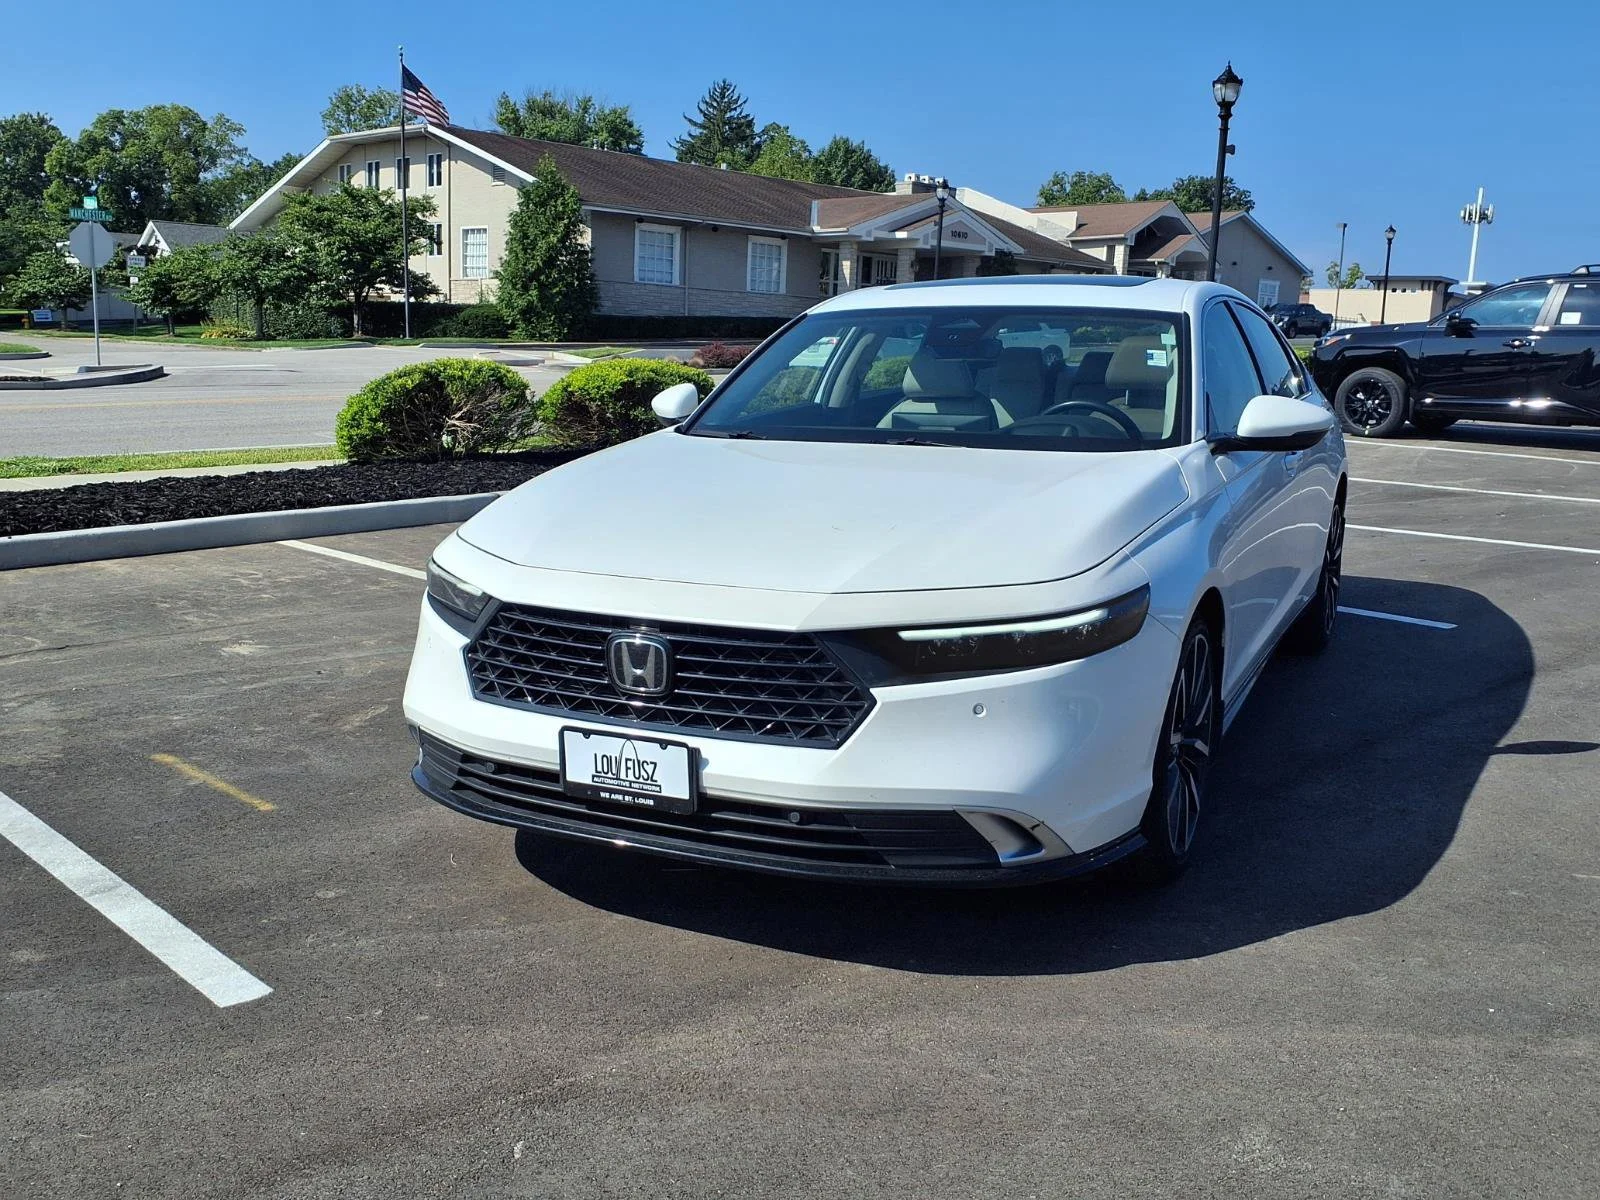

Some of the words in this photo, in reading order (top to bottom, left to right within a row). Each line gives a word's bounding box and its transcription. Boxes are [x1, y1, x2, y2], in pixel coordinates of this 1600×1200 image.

[951, 230, 968, 240] 10610
[594, 753, 618, 776] LOU
[625, 758, 658, 782] FUSZ
[593, 777, 631, 787] AUTOMOTIVE
[631, 783, 661, 792] NETWORK
[600, 791, 610, 799] WE
[611, 793, 624, 801] ARE
[635, 797, 654, 806] LOUIS
